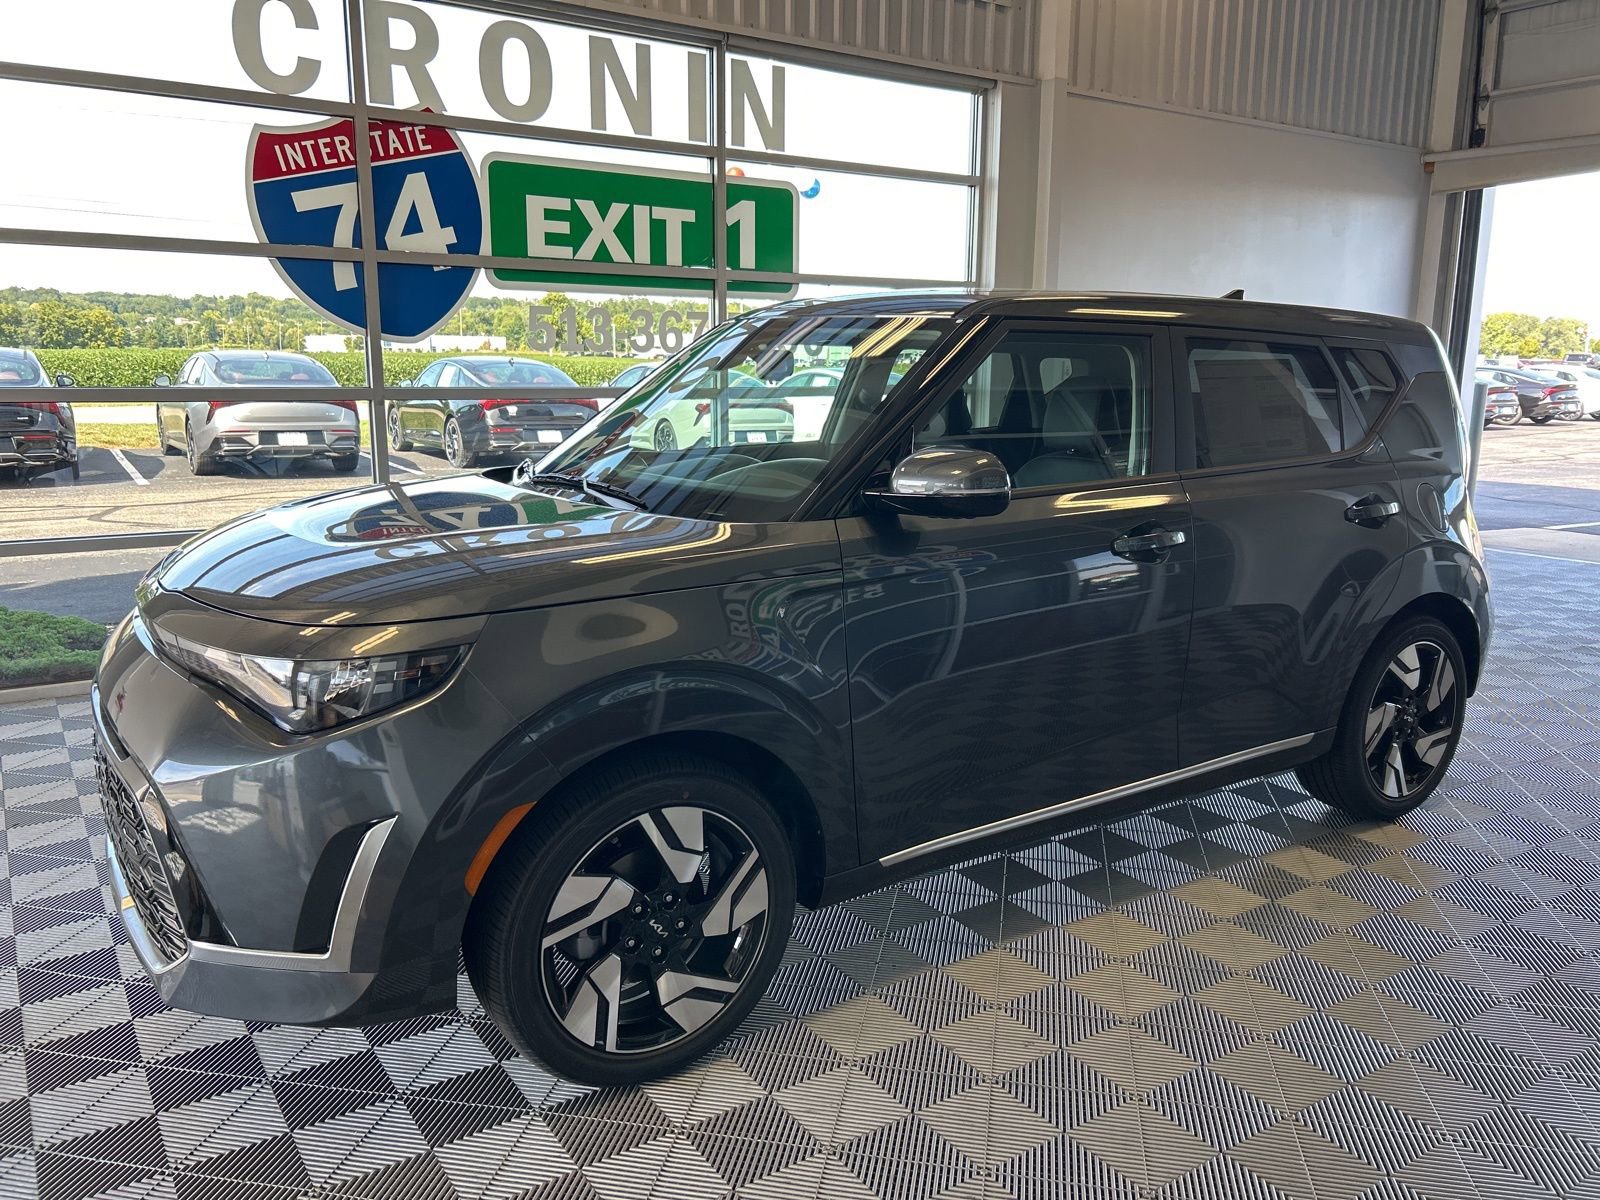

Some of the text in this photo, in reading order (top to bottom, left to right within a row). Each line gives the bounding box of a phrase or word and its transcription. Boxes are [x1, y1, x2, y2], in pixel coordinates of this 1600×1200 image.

[231, 0, 786, 153] CRONIN
[274, 125, 432, 172] INTERTATE
[290, 171, 458, 292] 74
[525, 194, 756, 270] EXIT 1
